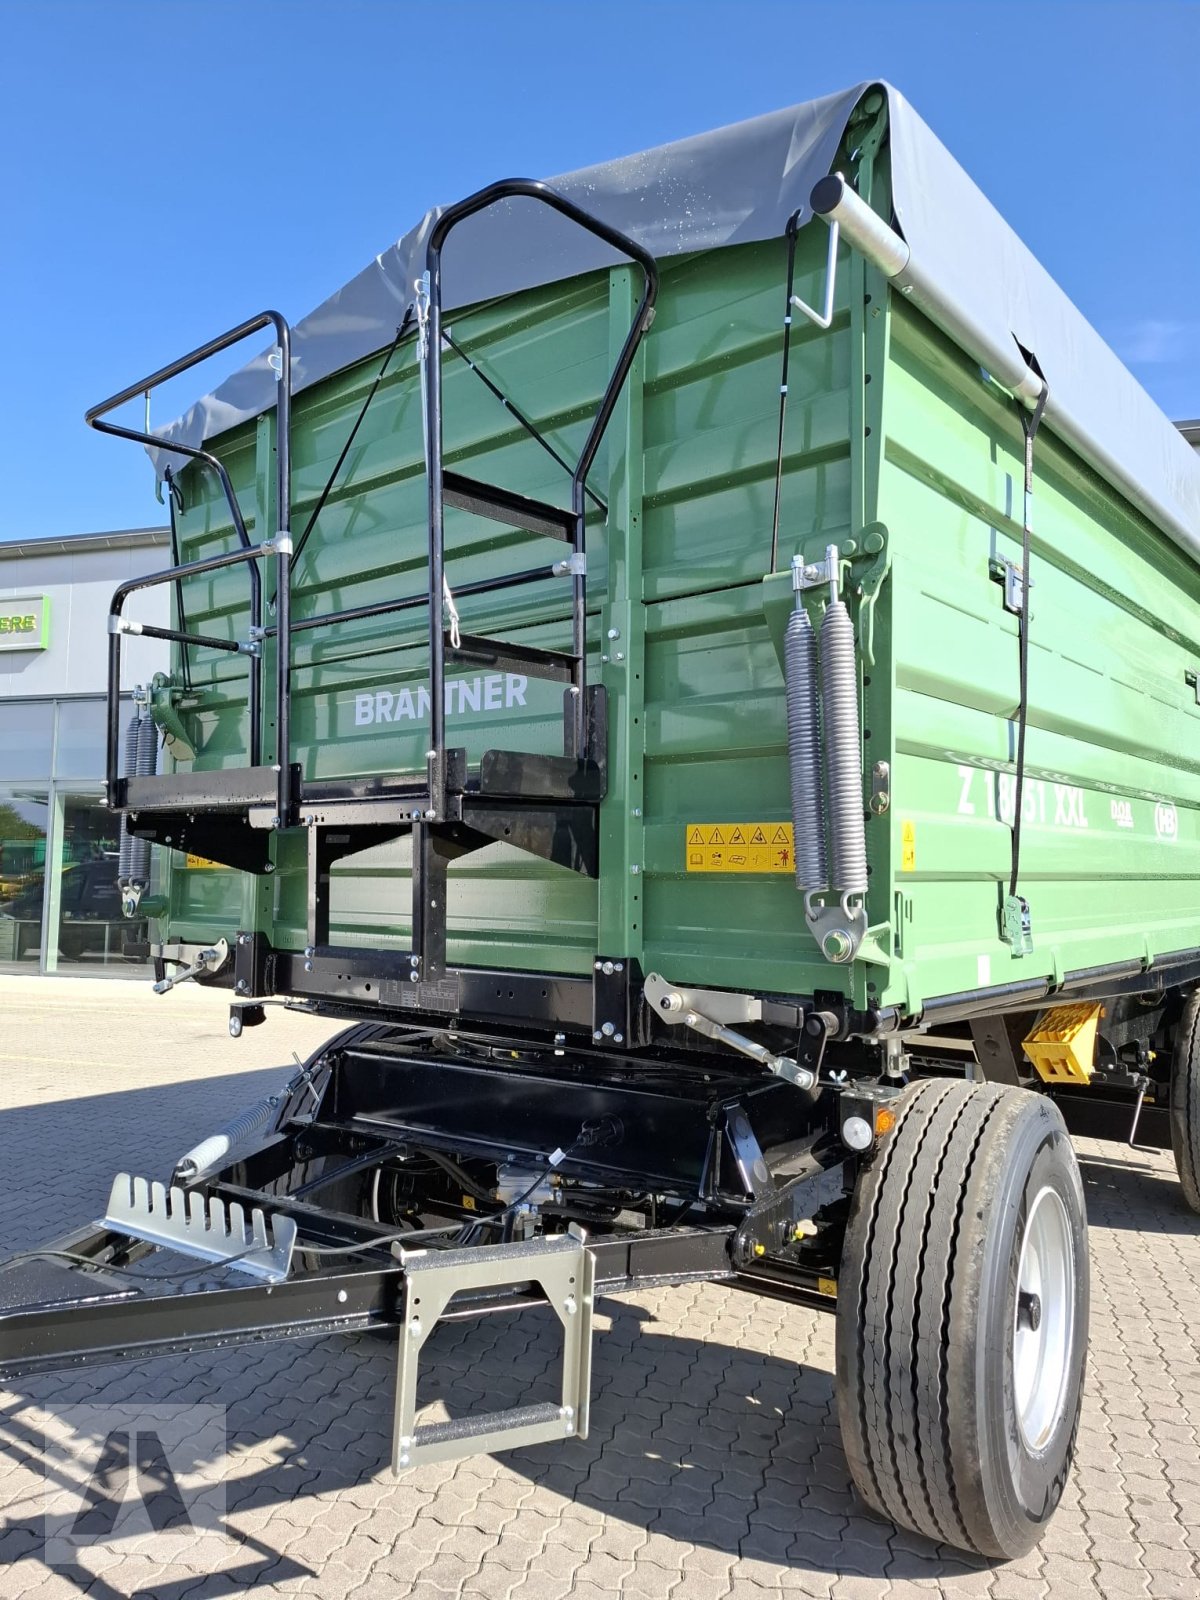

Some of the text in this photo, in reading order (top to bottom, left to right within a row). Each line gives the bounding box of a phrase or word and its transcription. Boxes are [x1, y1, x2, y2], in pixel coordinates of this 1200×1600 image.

[355, 673, 528, 726] BRANTNER
[957, 766, 975, 814] Z
[1054, 783, 1088, 828] XXL
